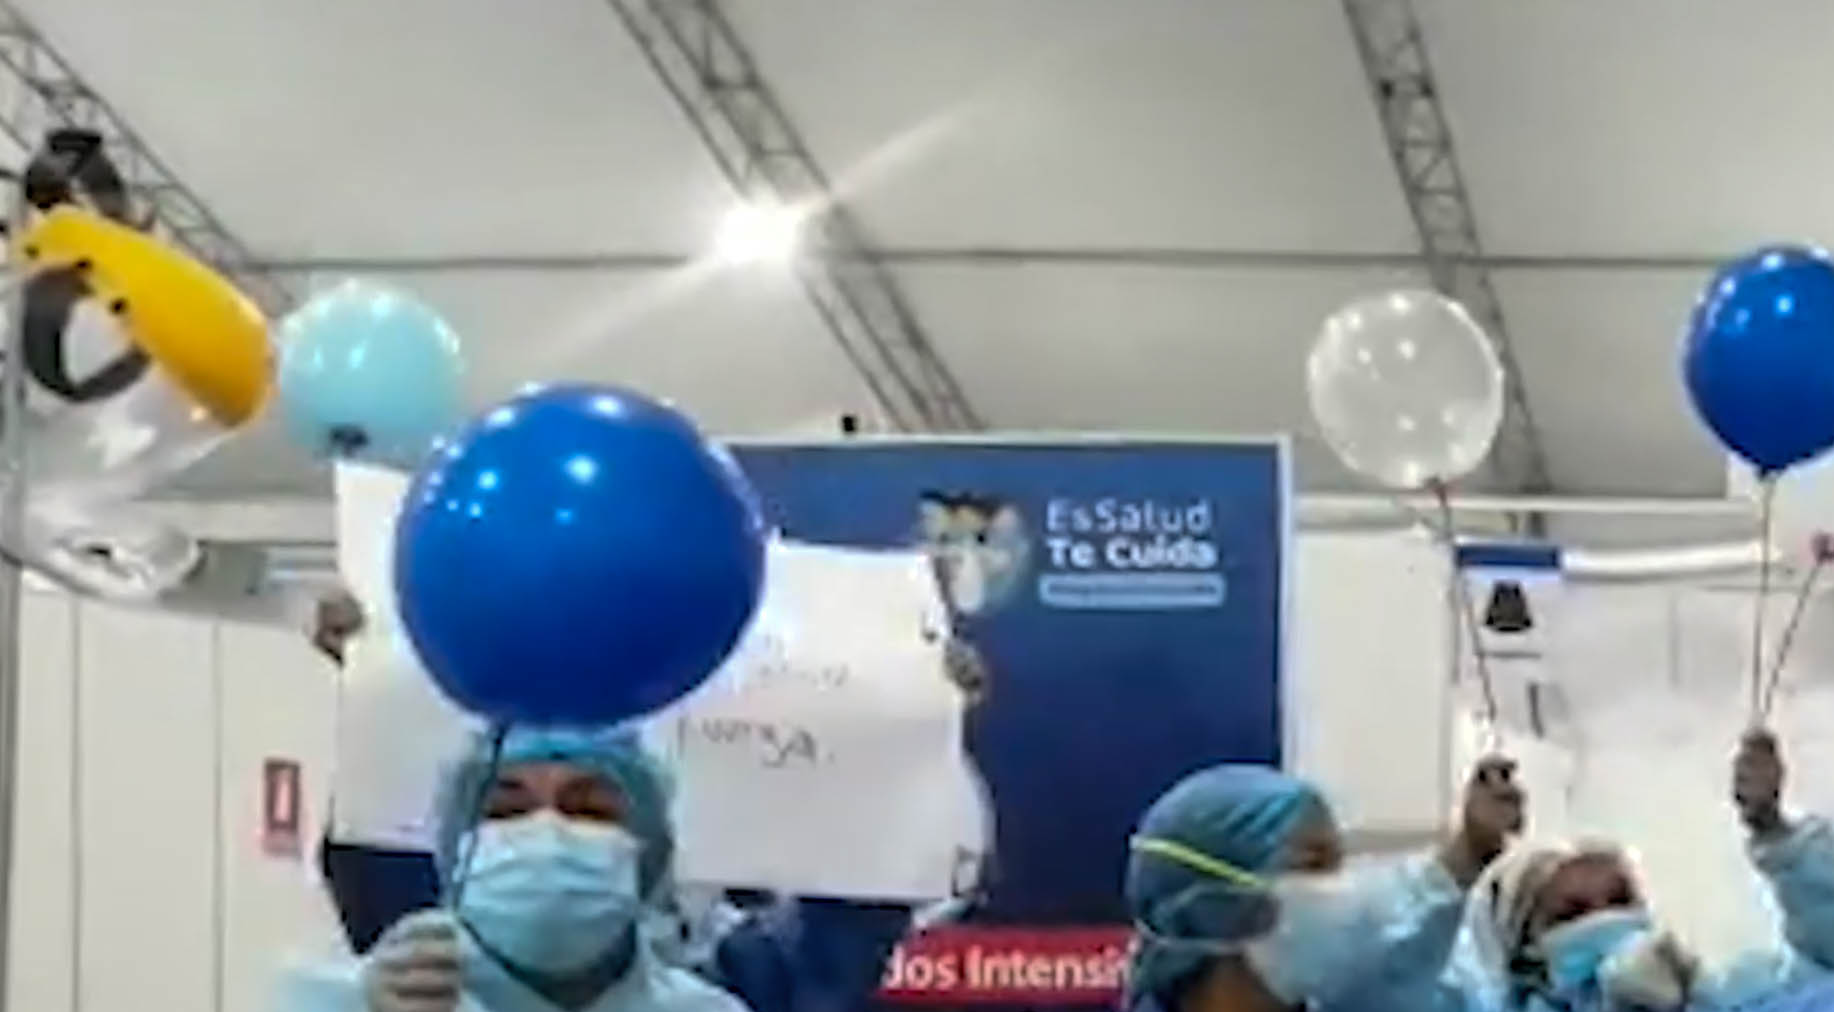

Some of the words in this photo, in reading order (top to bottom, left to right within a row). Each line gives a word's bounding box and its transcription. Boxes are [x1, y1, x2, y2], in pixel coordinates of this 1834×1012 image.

[1046, 498, 1212, 533] EsSalud
[1046, 536, 1096, 569] Te
[1105, 534, 1218, 569] Cuida
